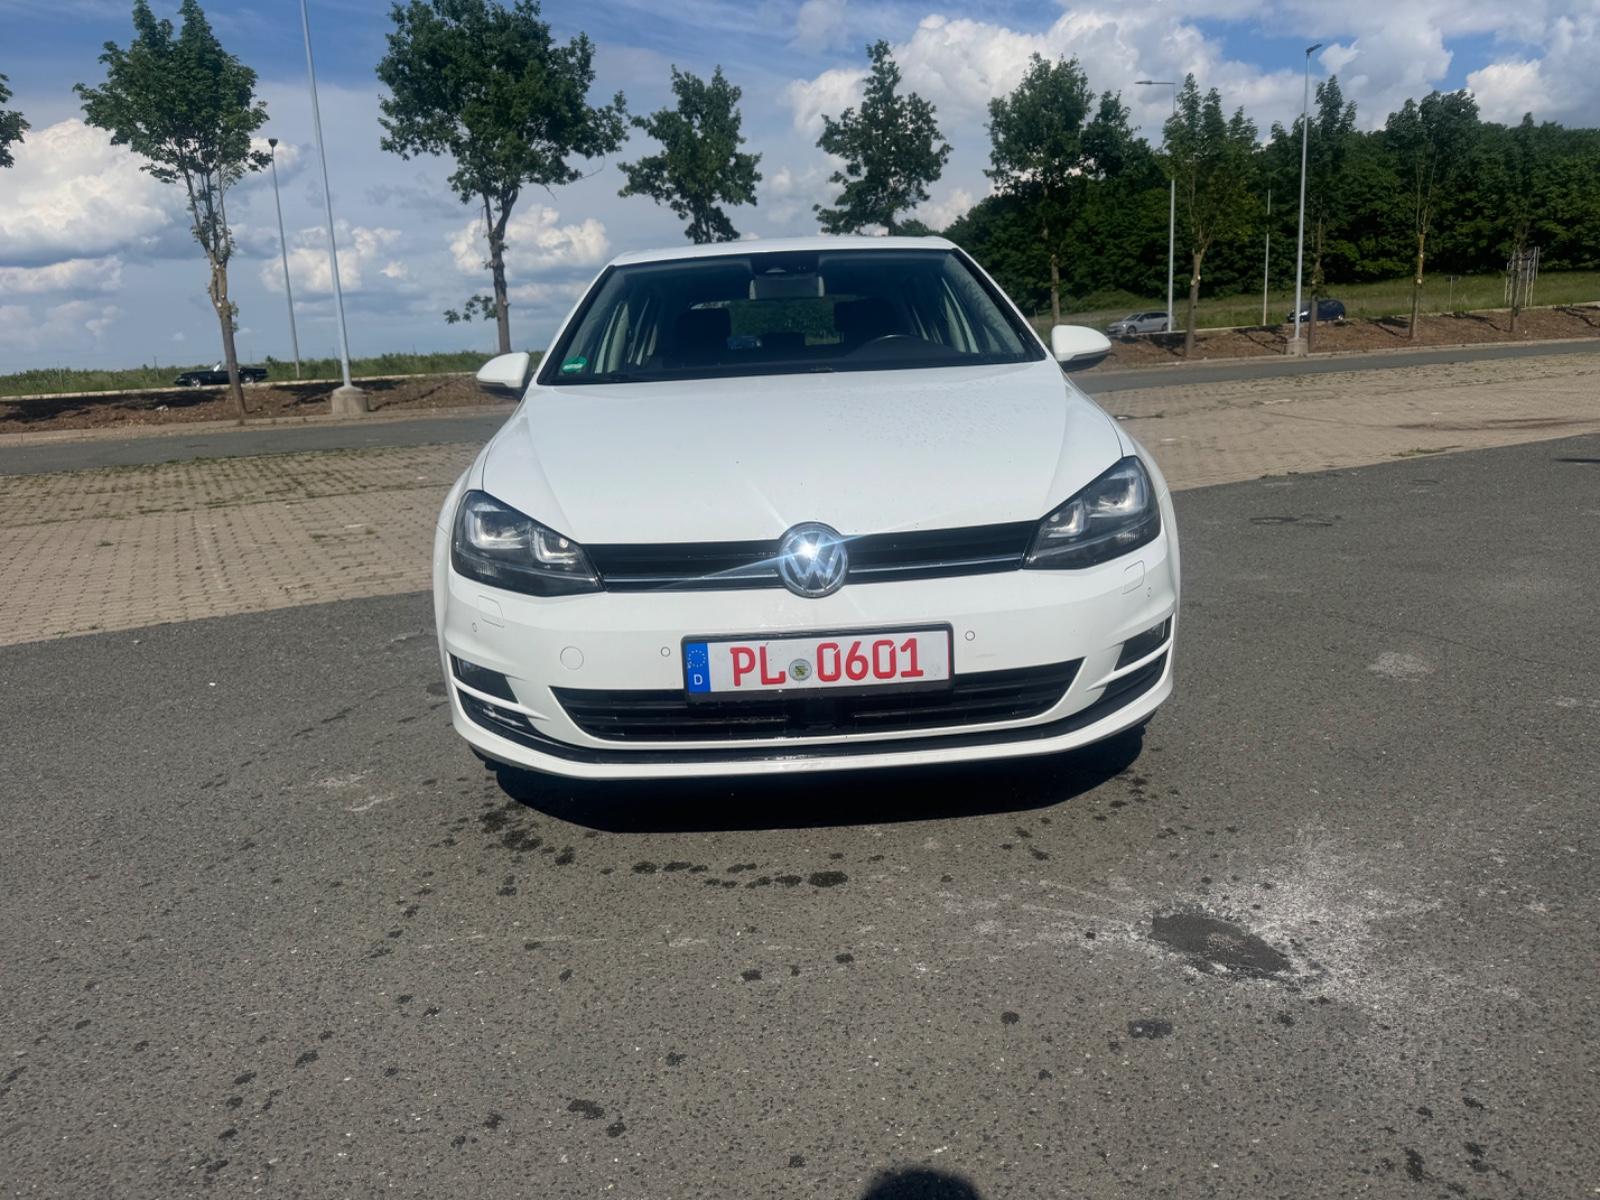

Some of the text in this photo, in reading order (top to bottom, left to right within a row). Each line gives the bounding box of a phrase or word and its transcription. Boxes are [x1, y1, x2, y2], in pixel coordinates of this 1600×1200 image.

[729, 638, 924, 687] PL 0601
[693, 673, 703, 686] D
